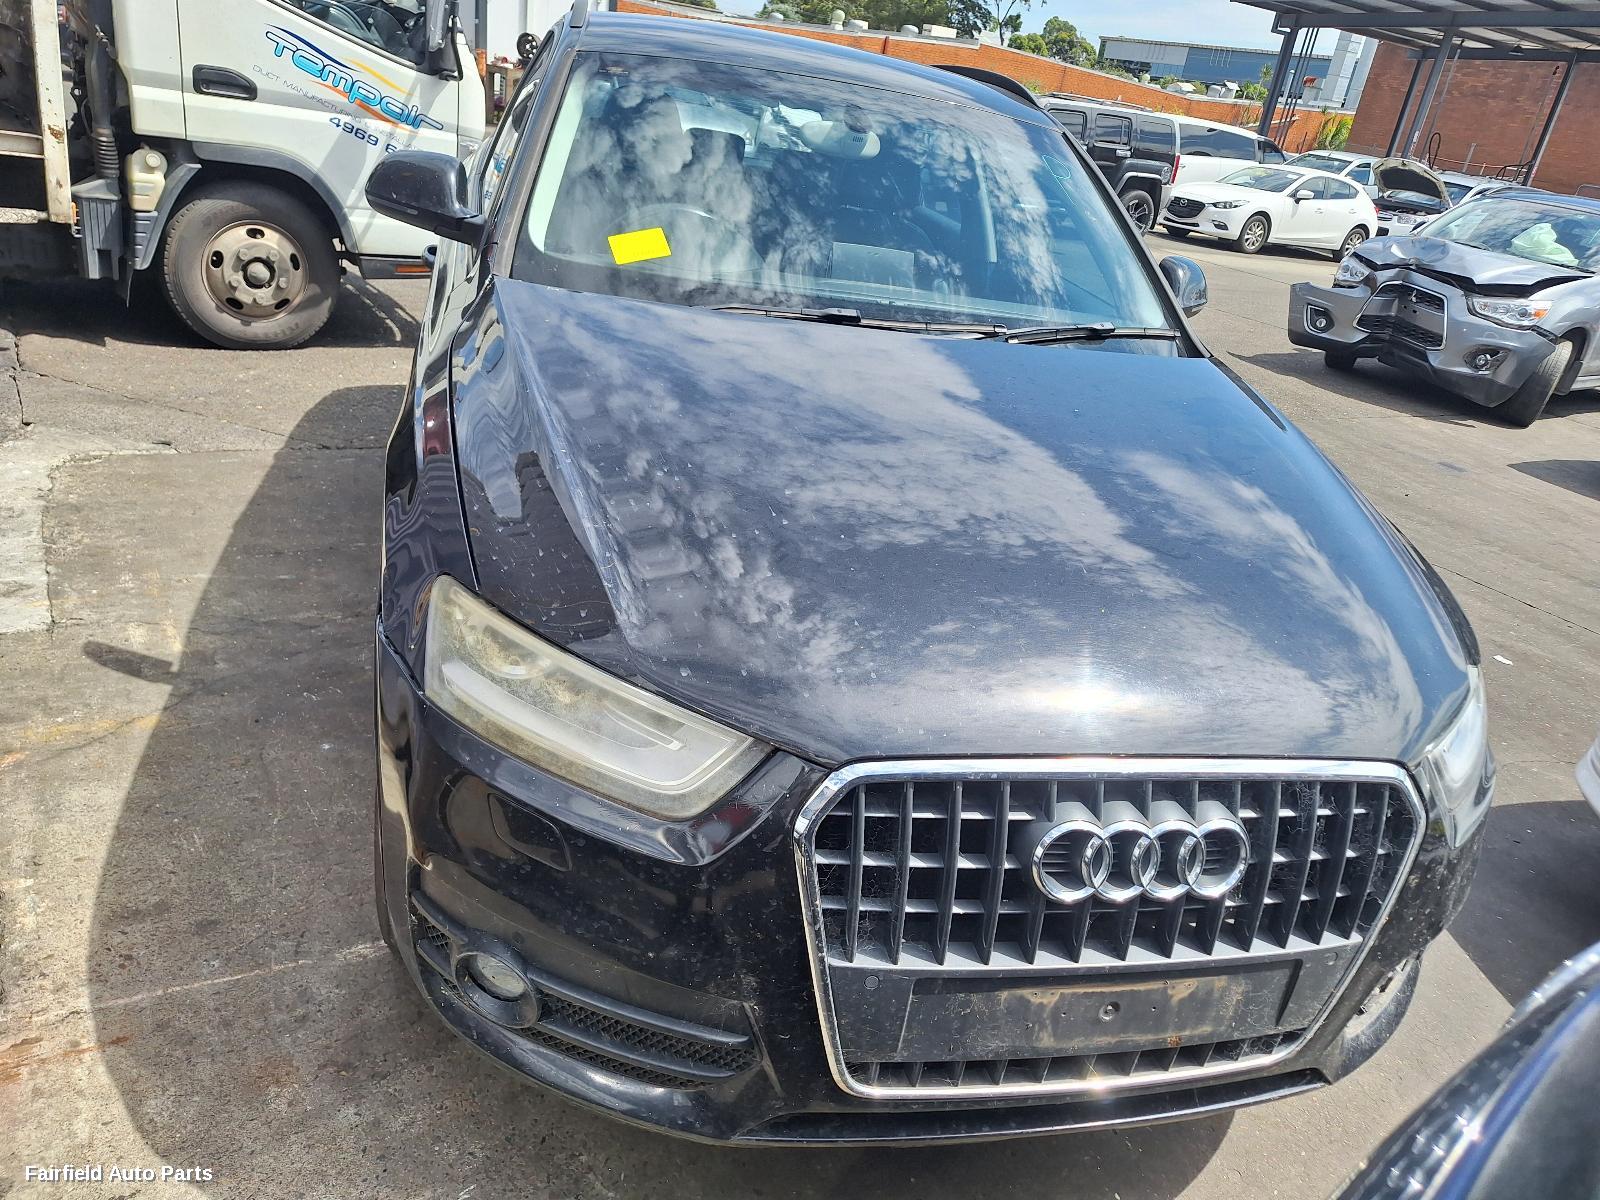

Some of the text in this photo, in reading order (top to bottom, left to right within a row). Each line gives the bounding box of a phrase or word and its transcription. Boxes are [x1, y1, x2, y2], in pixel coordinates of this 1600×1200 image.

[252, 64, 281, 81] DUCT
[282, 80, 362, 125] MANUFACTURING
[265, 30, 444, 130] Tempair
[329, 117, 379, 146] 4969
